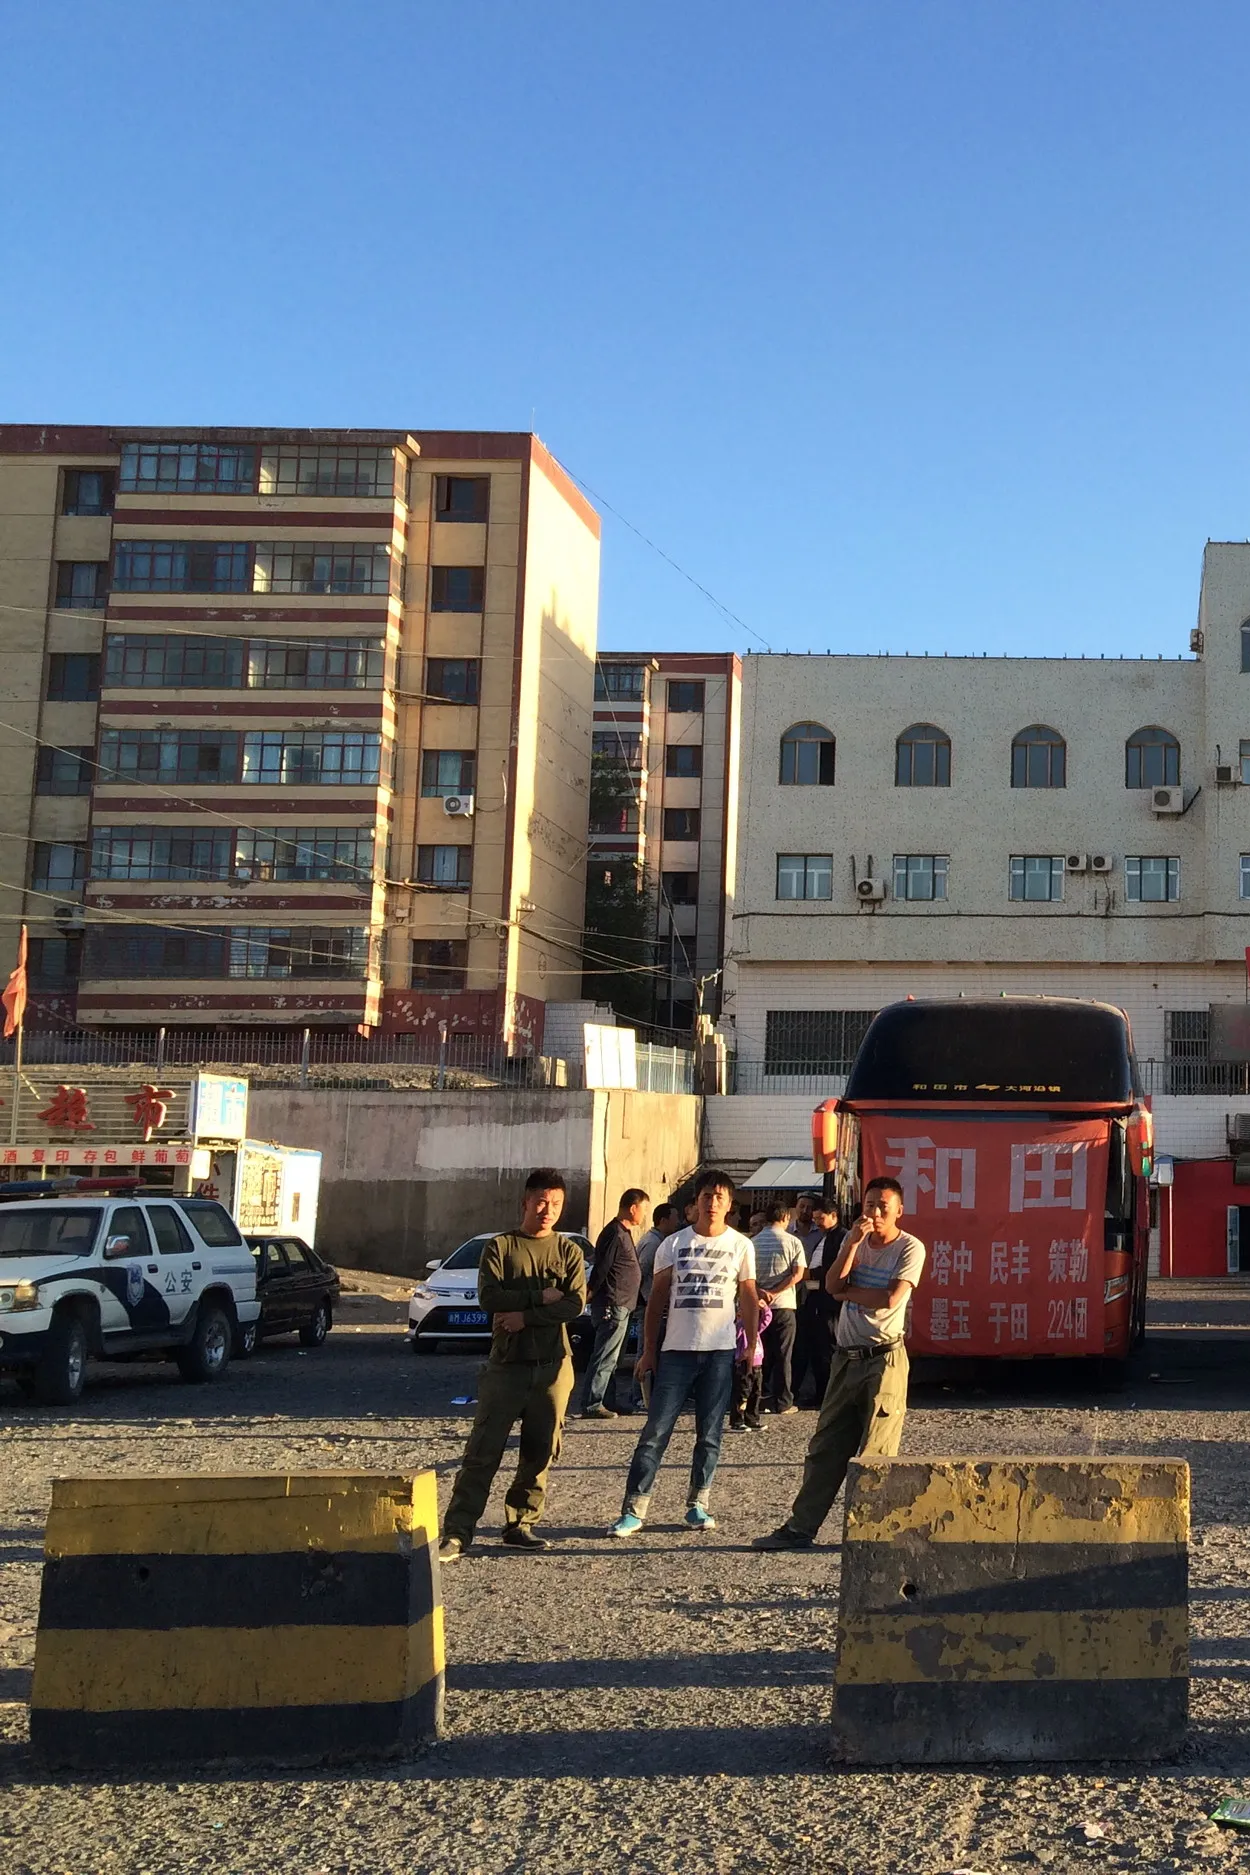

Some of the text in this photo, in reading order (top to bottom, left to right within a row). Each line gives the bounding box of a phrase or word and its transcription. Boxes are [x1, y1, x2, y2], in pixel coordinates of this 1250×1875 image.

[913, 1083, 968, 1091] 和田市
[36, 1084, 176, 1141] 超市
[885, 1136, 1087, 1215] 和田
[165, 1270, 192, 1293] 公安
[930, 1238, 1088, 1286] 塔中 民丰 策勒
[930, 1298, 971, 1341] 墨玉
[988, 1302, 1028, 1343] 于田
[1048, 1297, 1088, 1340] 224团
